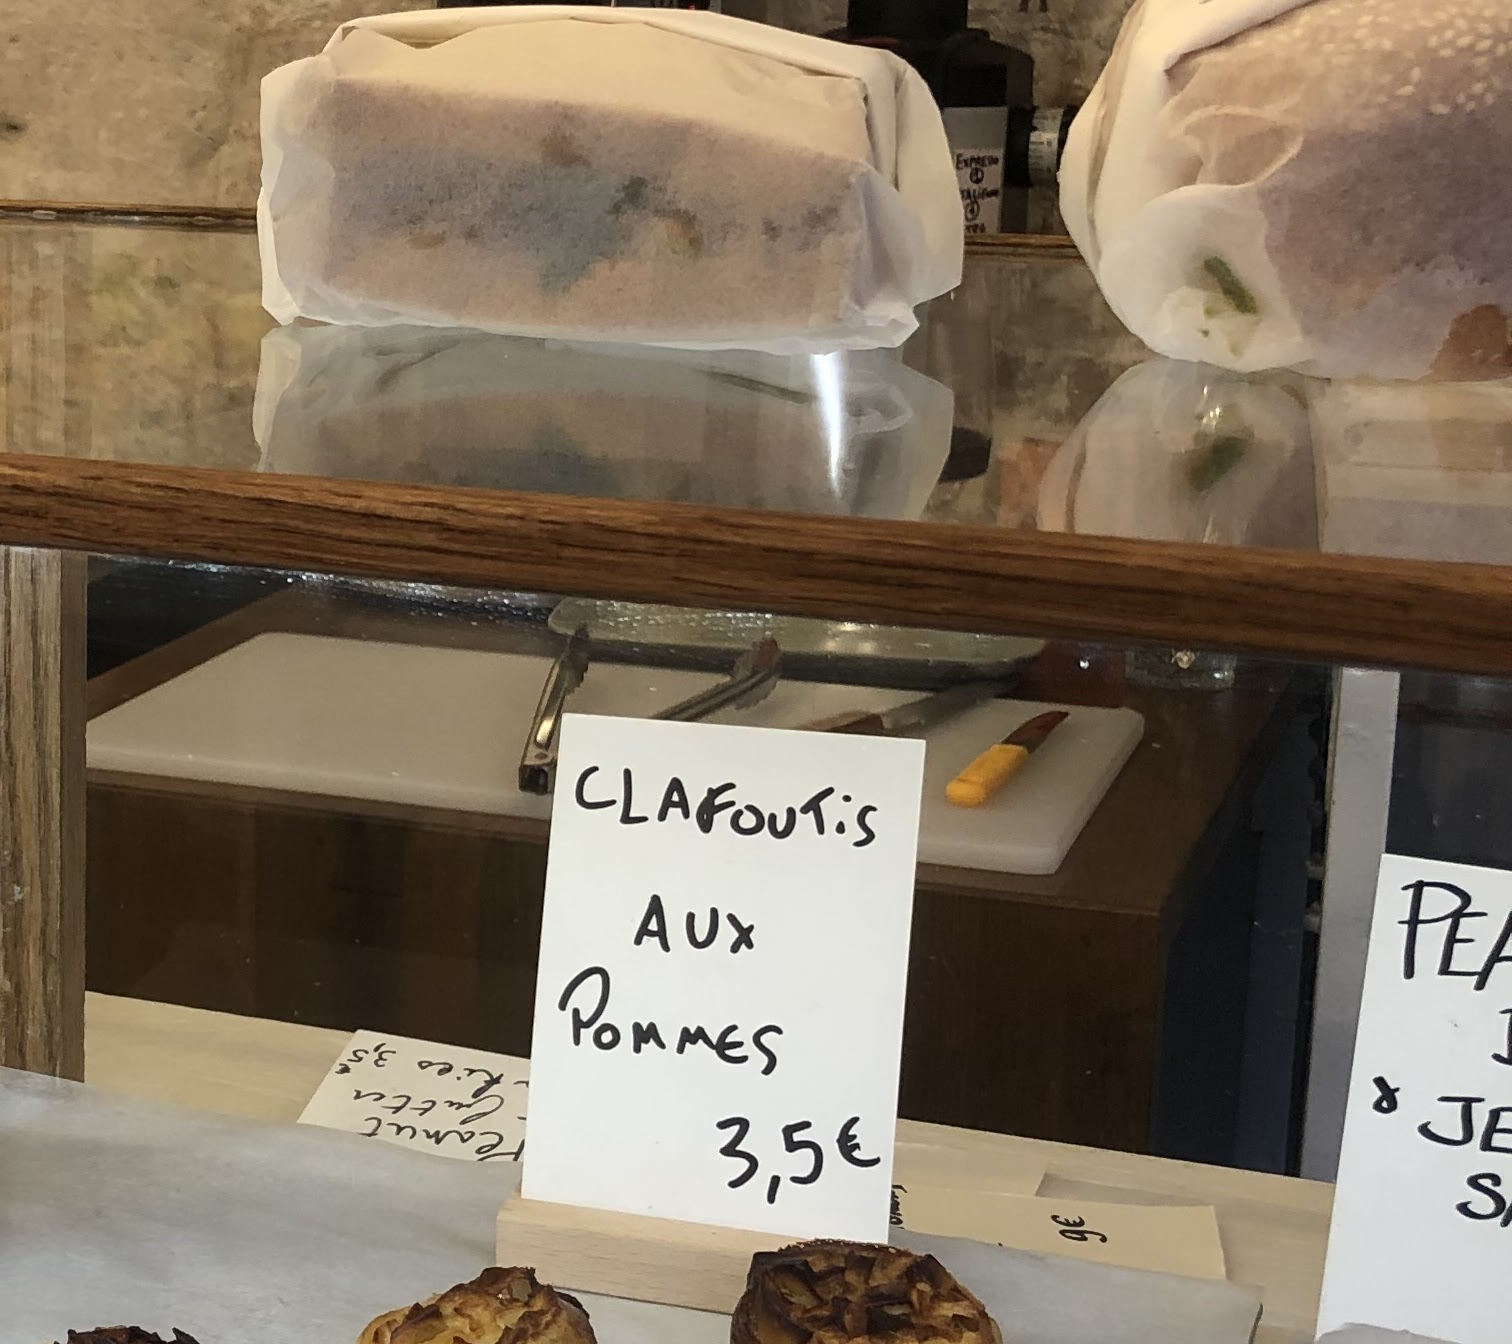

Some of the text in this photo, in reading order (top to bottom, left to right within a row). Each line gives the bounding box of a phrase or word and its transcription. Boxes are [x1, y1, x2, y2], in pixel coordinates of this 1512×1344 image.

[633, 893, 755, 954] AUX
[558, 966, 784, 1076] POMMES
[715, 1115, 881, 1205] 3,5€
[1417, 1096, 1512, 1154] JE
